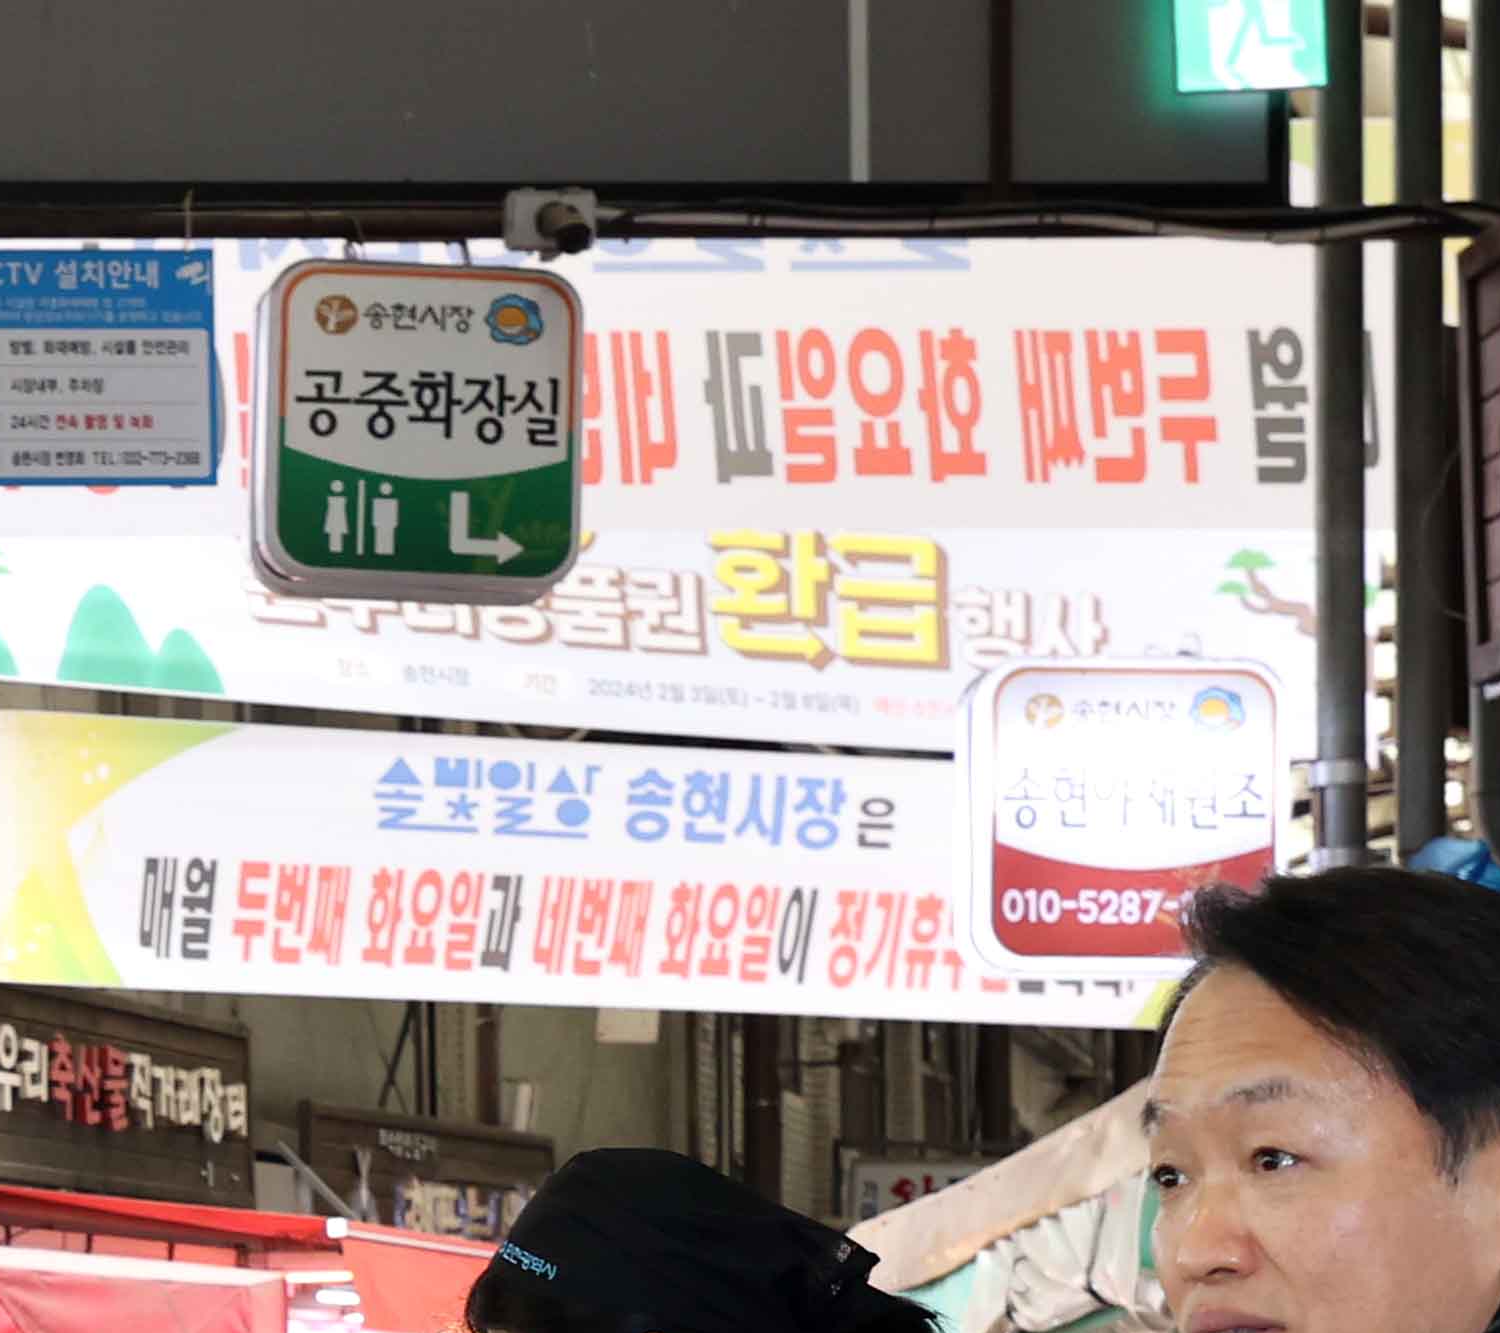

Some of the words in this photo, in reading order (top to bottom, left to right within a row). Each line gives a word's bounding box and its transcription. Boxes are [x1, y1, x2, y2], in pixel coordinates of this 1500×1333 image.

[55, 259, 160, 289] 설치안내
[363, 302, 475, 334] 송현시장
[295, 368, 562, 447] 공중화장실
[705, 528, 952, 670] 환급
[140, 855, 218, 961] 매월
[231, 859, 353, 968] 두번째
[362, 866, 524, 972] 화요일과
[531, 874, 656, 980] 네번째
[657, 881, 826, 986] 화요일이
[1001, 885, 1198, 928] 010-5287-
